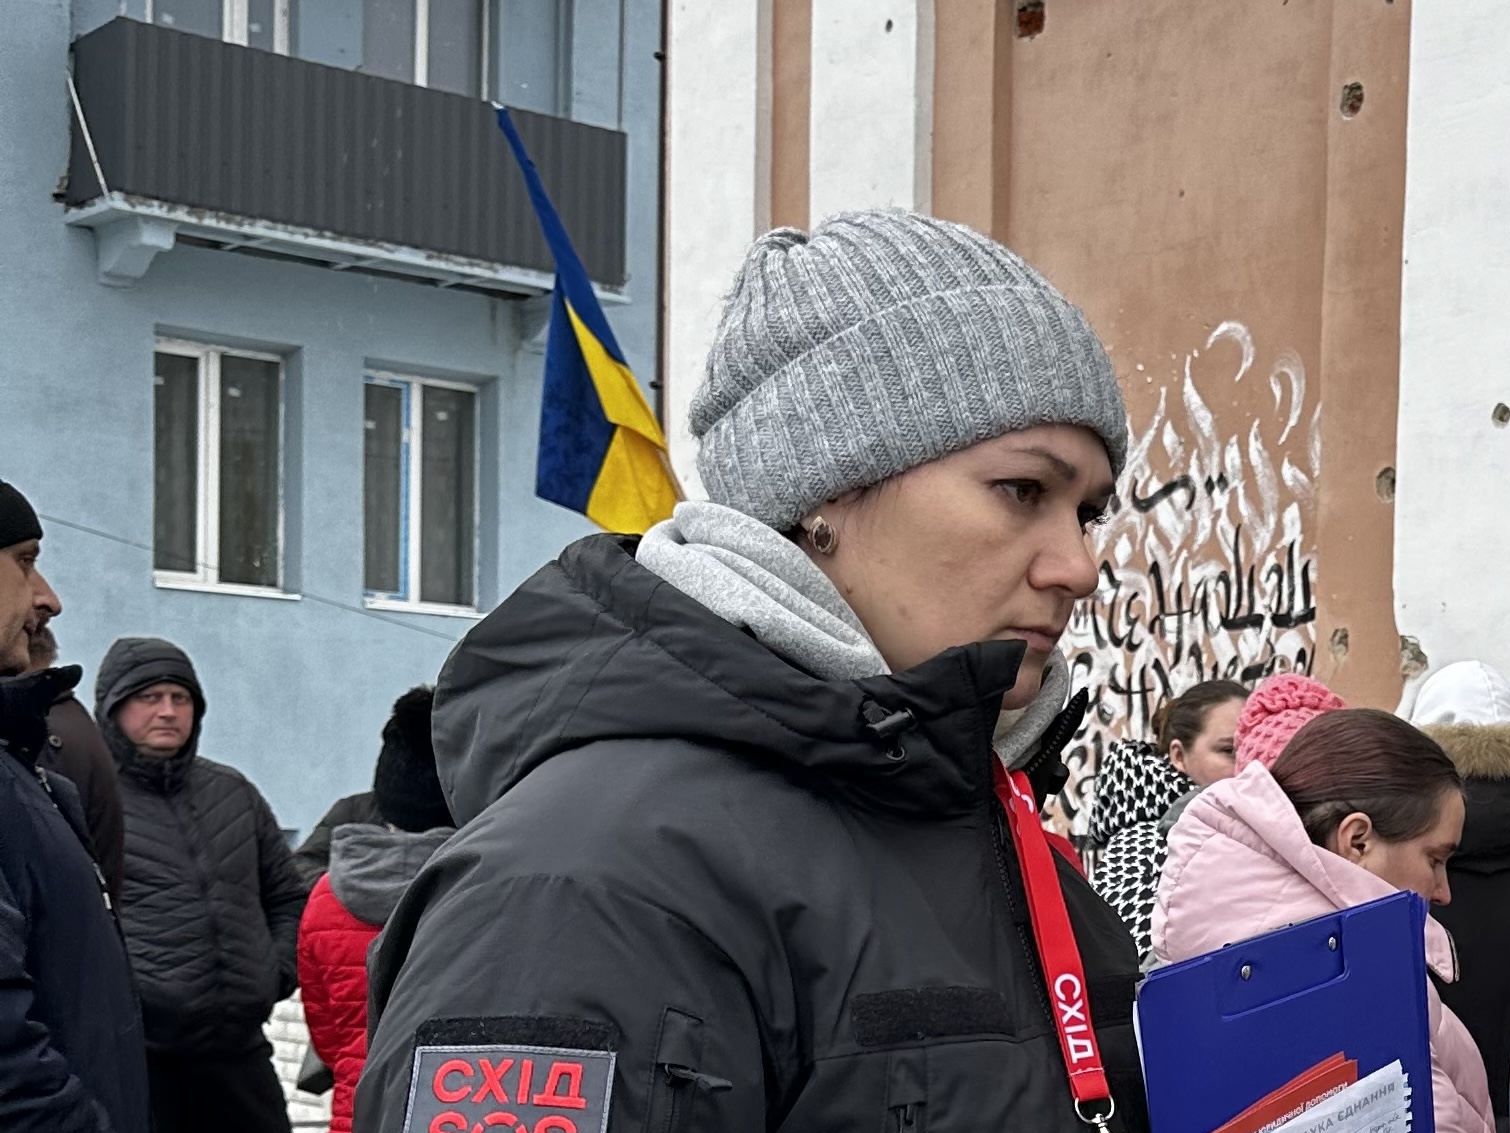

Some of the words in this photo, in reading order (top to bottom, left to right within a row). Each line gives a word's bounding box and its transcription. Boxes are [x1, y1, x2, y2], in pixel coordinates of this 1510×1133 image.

[1054, 973, 1094, 1064] СХІД
[432, 1058, 587, 1109] СХІД
[1337, 1082, 1395, 1121] ЄДНАННЯ
